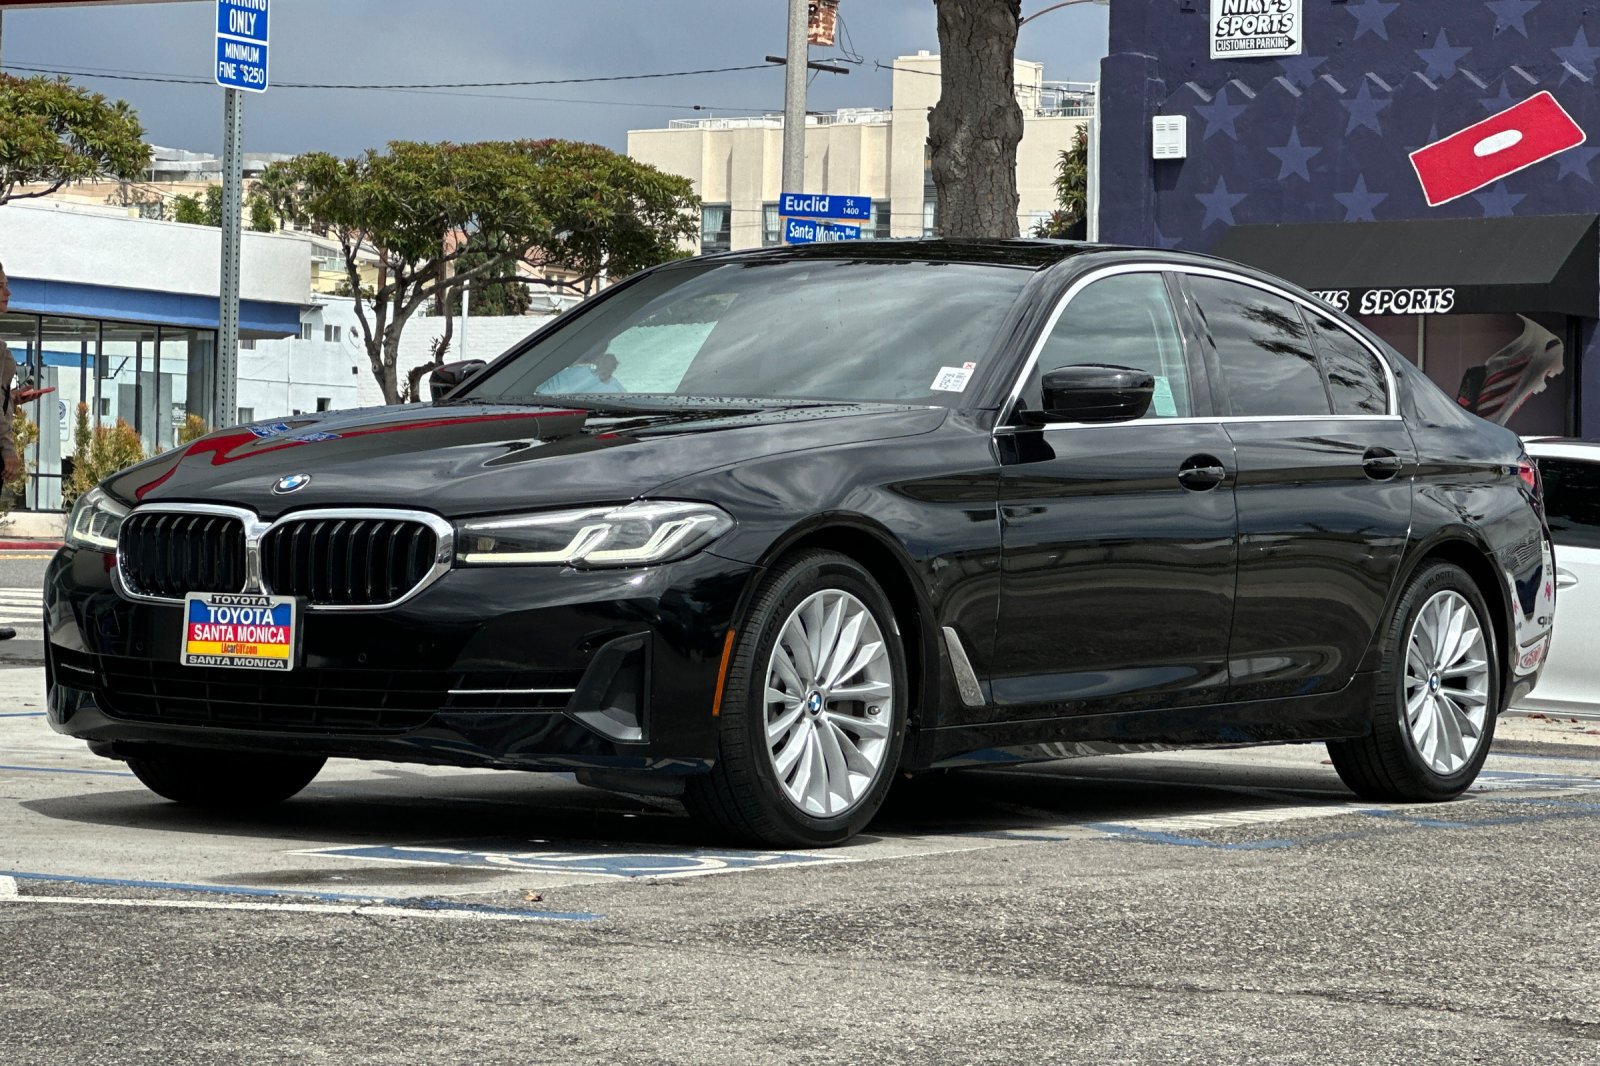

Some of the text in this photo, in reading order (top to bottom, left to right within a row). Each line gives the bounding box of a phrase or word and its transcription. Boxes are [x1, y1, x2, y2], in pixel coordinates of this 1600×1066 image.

[229, 8, 257, 36] ONLY
[1215, 13, 1294, 36] SPORTS
[225, 42, 260, 64] MINIMUM
[1216, 36, 1289, 51] CUSTOMER PARKING
[219, 61, 264, 85] FINE $250
[785, 196, 830, 212] Euclid
[842, 207, 859, 215] 1400
[789, 221, 856, 242] Santa Monica Blvd
[1359, 288, 1455, 315] SPORTS
[213, 595, 268, 606] TOYOTA
[207, 606, 274, 626] TOYOTA
[194, 624, 285, 643] SANTA MONICA
[189, 655, 284, 668] SANTA MONICA
